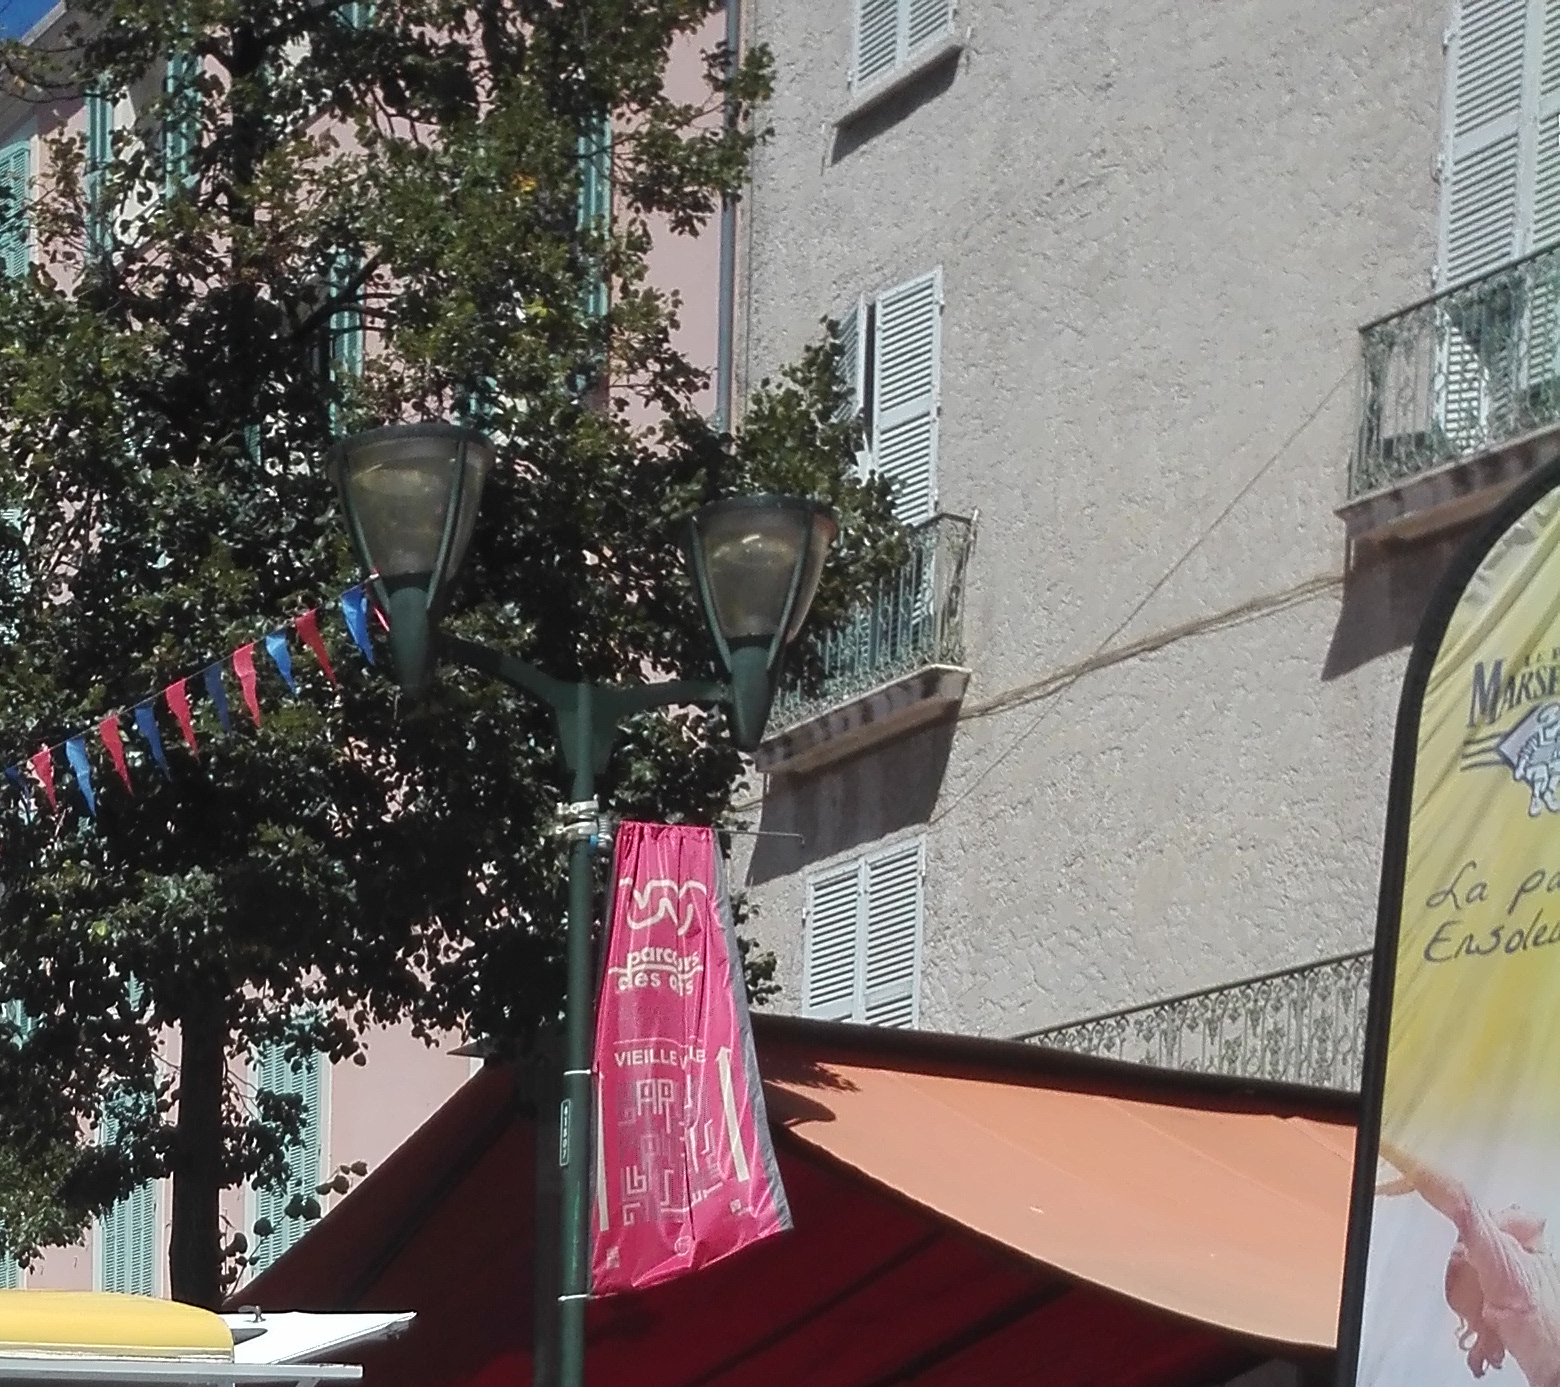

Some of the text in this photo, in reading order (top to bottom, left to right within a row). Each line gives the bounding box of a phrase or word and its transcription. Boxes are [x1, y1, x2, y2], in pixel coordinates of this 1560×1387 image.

[1426, 860, 1488, 910] La
[618, 968, 694, 997] des ats
[614, 1045, 706, 1070] VIEILLE VLE
